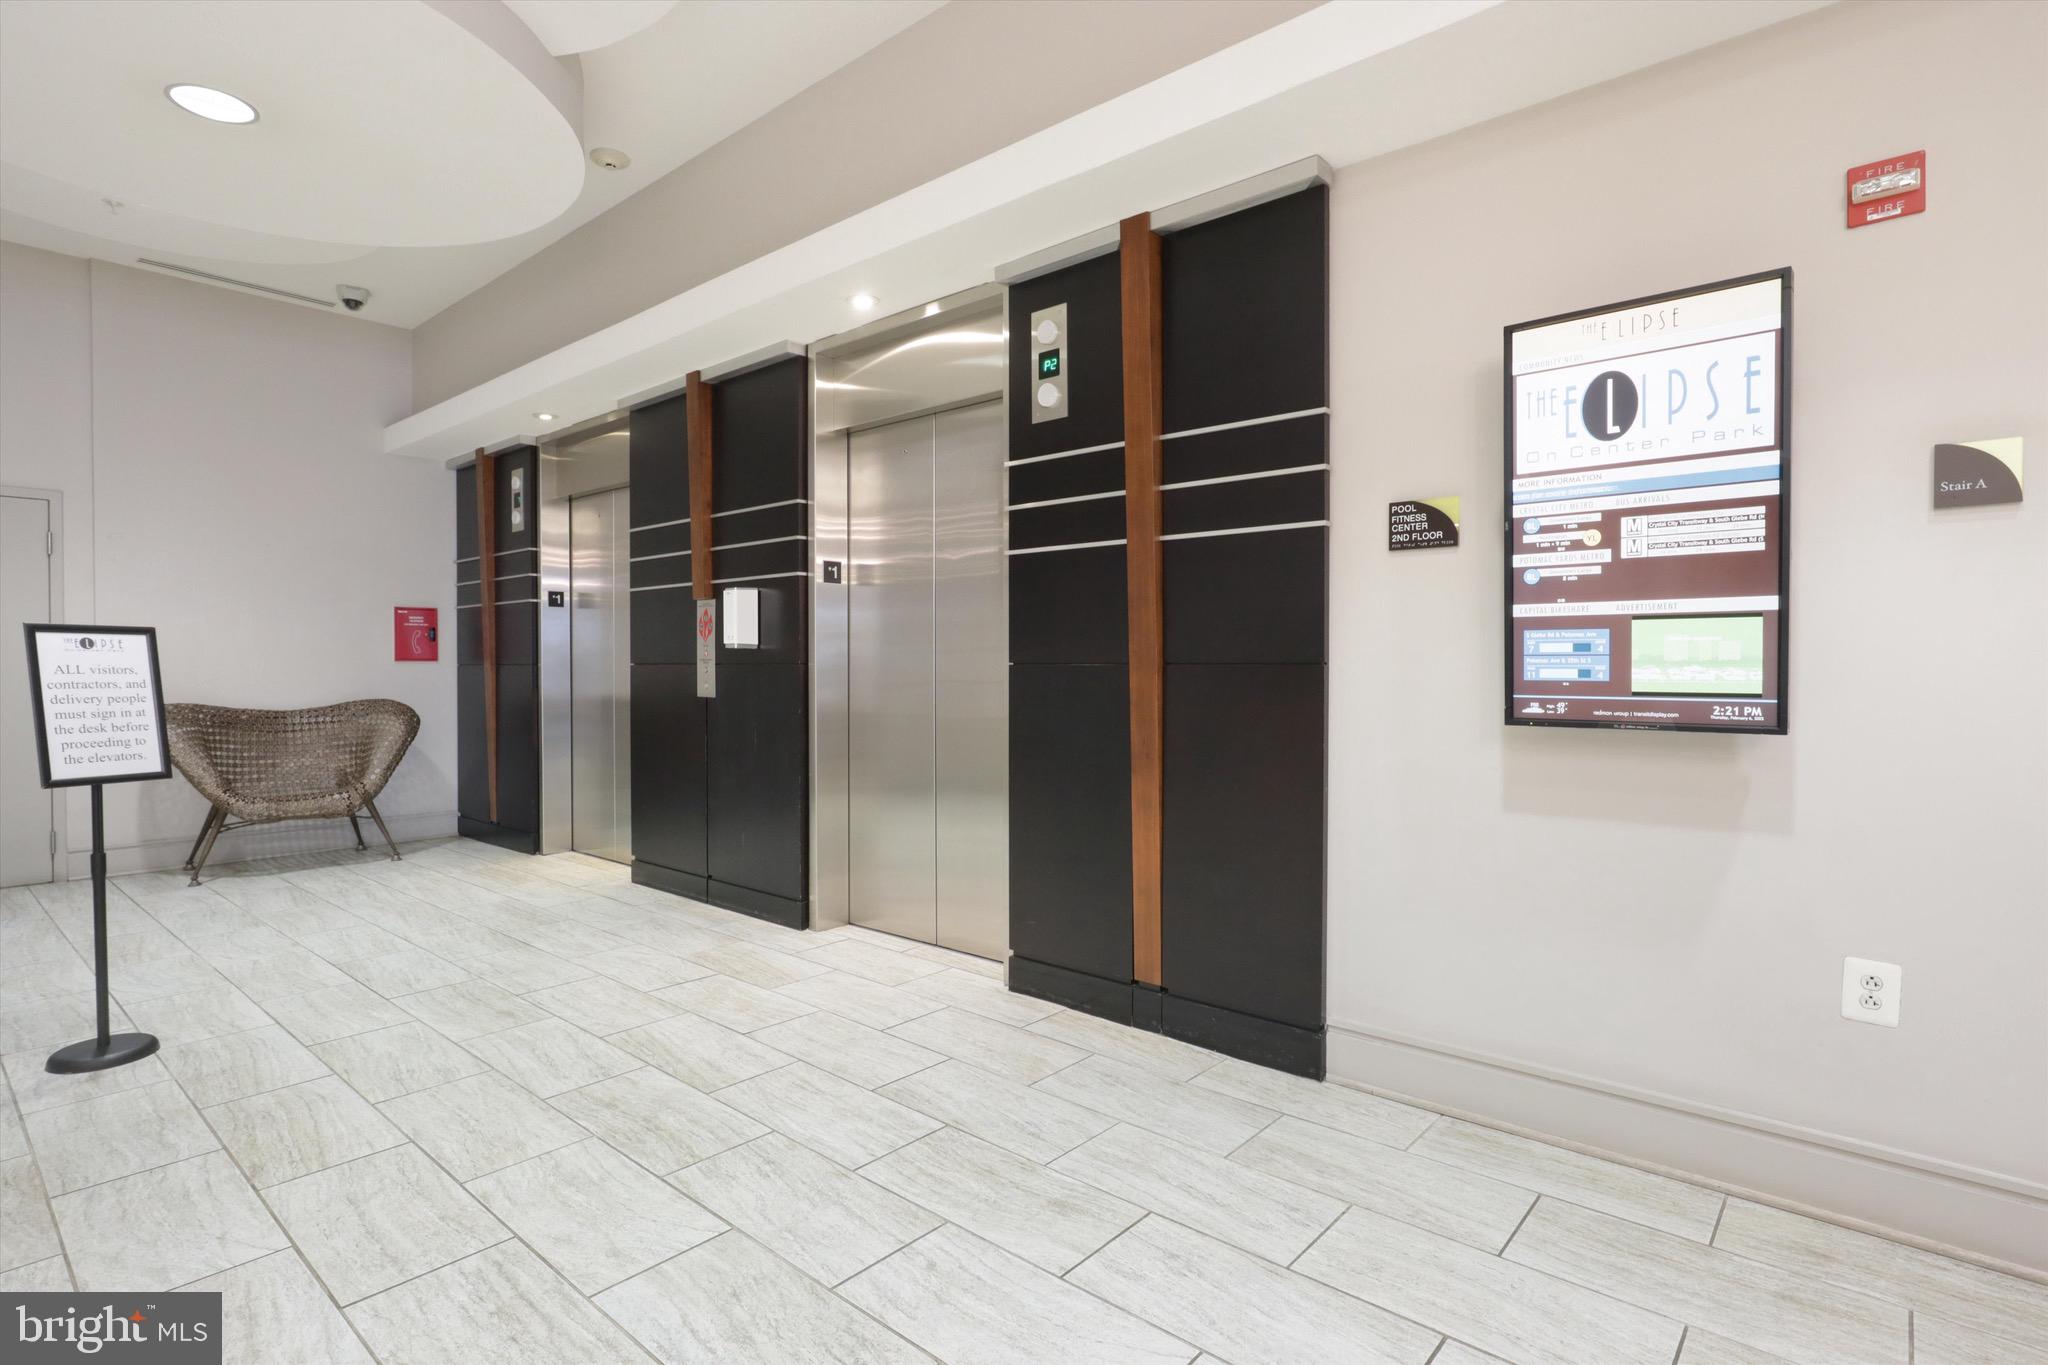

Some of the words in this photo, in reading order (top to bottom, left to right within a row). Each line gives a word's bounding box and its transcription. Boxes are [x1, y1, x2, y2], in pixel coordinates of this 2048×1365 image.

[1866, 162, 1905, 178] FIRE
[1866, 200, 1905, 217] FIRE
[1581, 322, 1597, 337] THE
[1601, 307, 1680, 341] ELIPSE
[1044, 358, 1057, 372] P2
[1519, 359, 1561, 371] COMMUNITY
[1526, 388, 1557, 420] THE
[1563, 355, 1761, 441] ELIPSE
[1526, 451, 1557, 464] On
[1570, 438, 1670, 458] Center
[1692, 424, 1765, 443] Park
[1518, 480, 1539, 489] MORE
[1543, 473, 1602, 486] INFORMATION
[1940, 480, 1973, 492] Stair
[1975, 478, 1987, 489] A
[1570, 501, 1594, 511] METRO
[1616, 496, 1629, 506] BUS
[1633, 494, 1671, 504] ARRIVALS
[1391, 504, 1417, 514] POOL
[1391, 513, 1427, 524] FITNESS
[1648, 521, 1666, 529] Crystal
[1667, 520, 1678, 528] City
[1680, 518, 1707, 526] Transitway
[1391, 522, 1429, 533] CENTER
[1391, 533, 1410, 542] 2ND
[1412, 530, 1443, 541] FLOOR
[1648, 542, 1666, 550] Crystal
[1680, 540, 1707, 548] Transitway
[1580, 552, 1605, 561] METRO
[1520, 607, 1547, 615] CAPITAL
[1551, 605, 1590, 613] BIKESHARE
[1616, 601, 1678, 612] ADVERTISEMENT
[74, 637, 124, 650] ELIPSE
[54, 664, 85, 675] ALL
[89, 665, 138, 676] visitors,
[47, 680, 122, 690] contractors,
[126, 679, 146, 689] and
[50, 694, 103, 706] delivery
[107, 692, 147, 706] people
[54, 710, 86, 720] must
[90, 708, 116, 721] sign
[121, 708, 132, 717] in
[135, 708, 146, 717] at
[1712, 705, 1739, 716] 2:21
[1744, 706, 1762, 717] PM
[54, 724, 75, 735] the
[78, 723, 107, 734] desk
[111, 721, 149, 732] before
[61, 737, 131, 752] proceeding
[135, 736, 146, 746] to
[64, 754, 84, 765] the
[87, 751, 147, 764] elevators.
